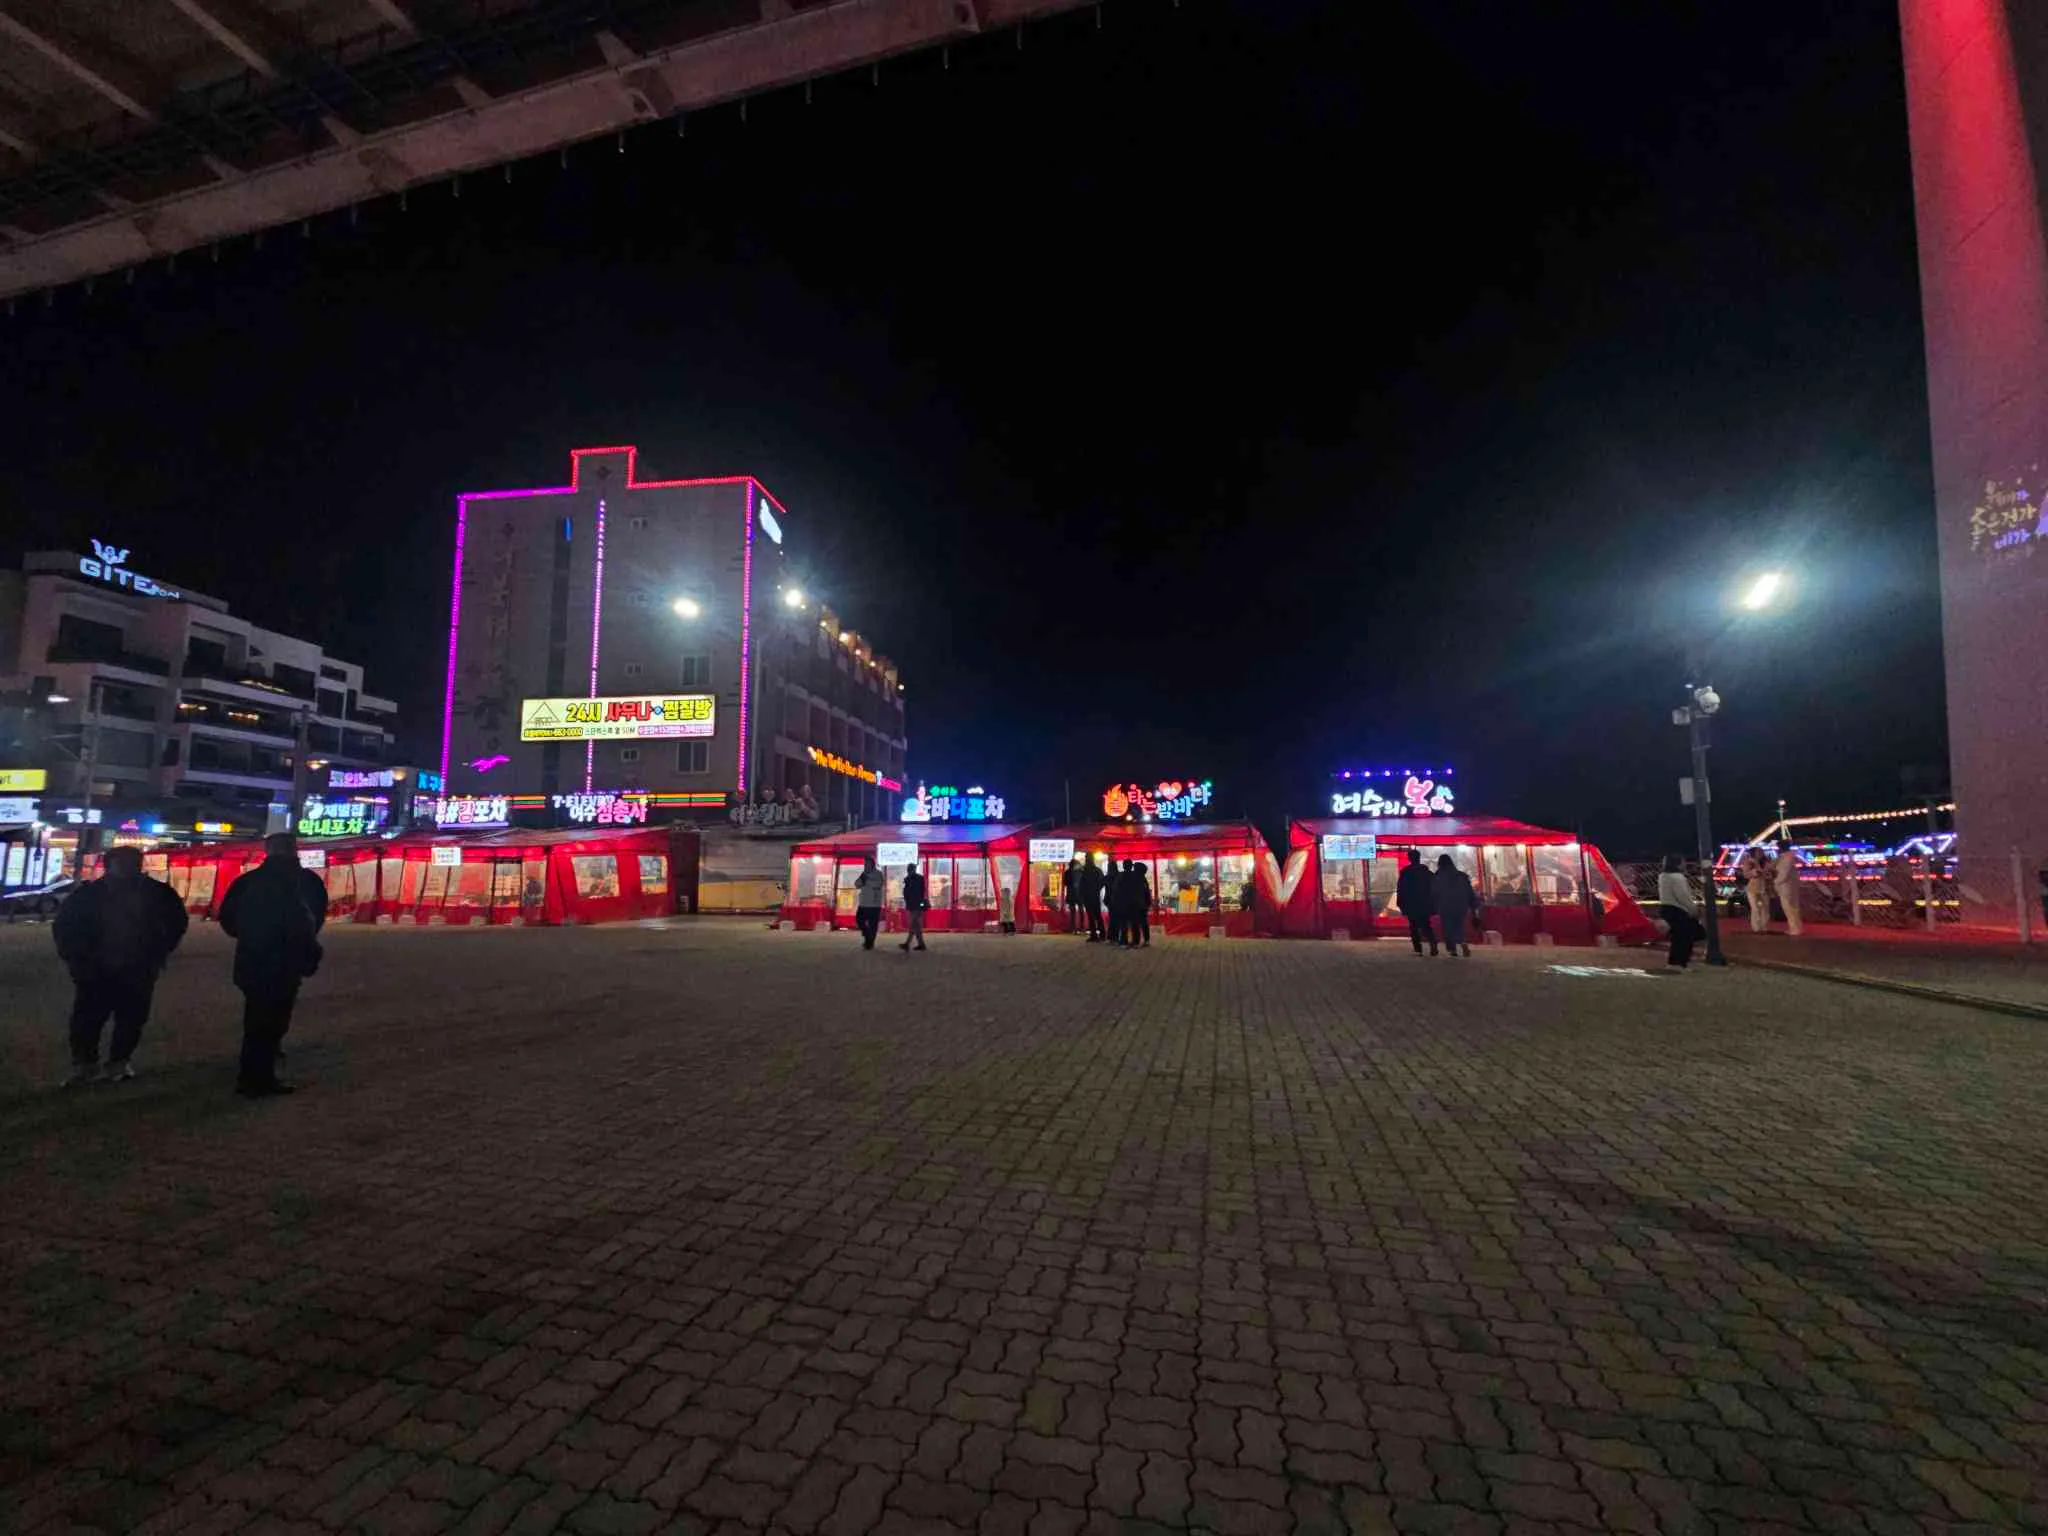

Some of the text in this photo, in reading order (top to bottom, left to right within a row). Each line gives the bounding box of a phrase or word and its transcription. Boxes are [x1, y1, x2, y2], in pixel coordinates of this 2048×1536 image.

[604, 701, 652, 722] 사우나
[662, 699, 712, 721] 찜질방
[931, 796, 1005, 820] 바다포차
[1404, 776, 1434, 816] 봄
